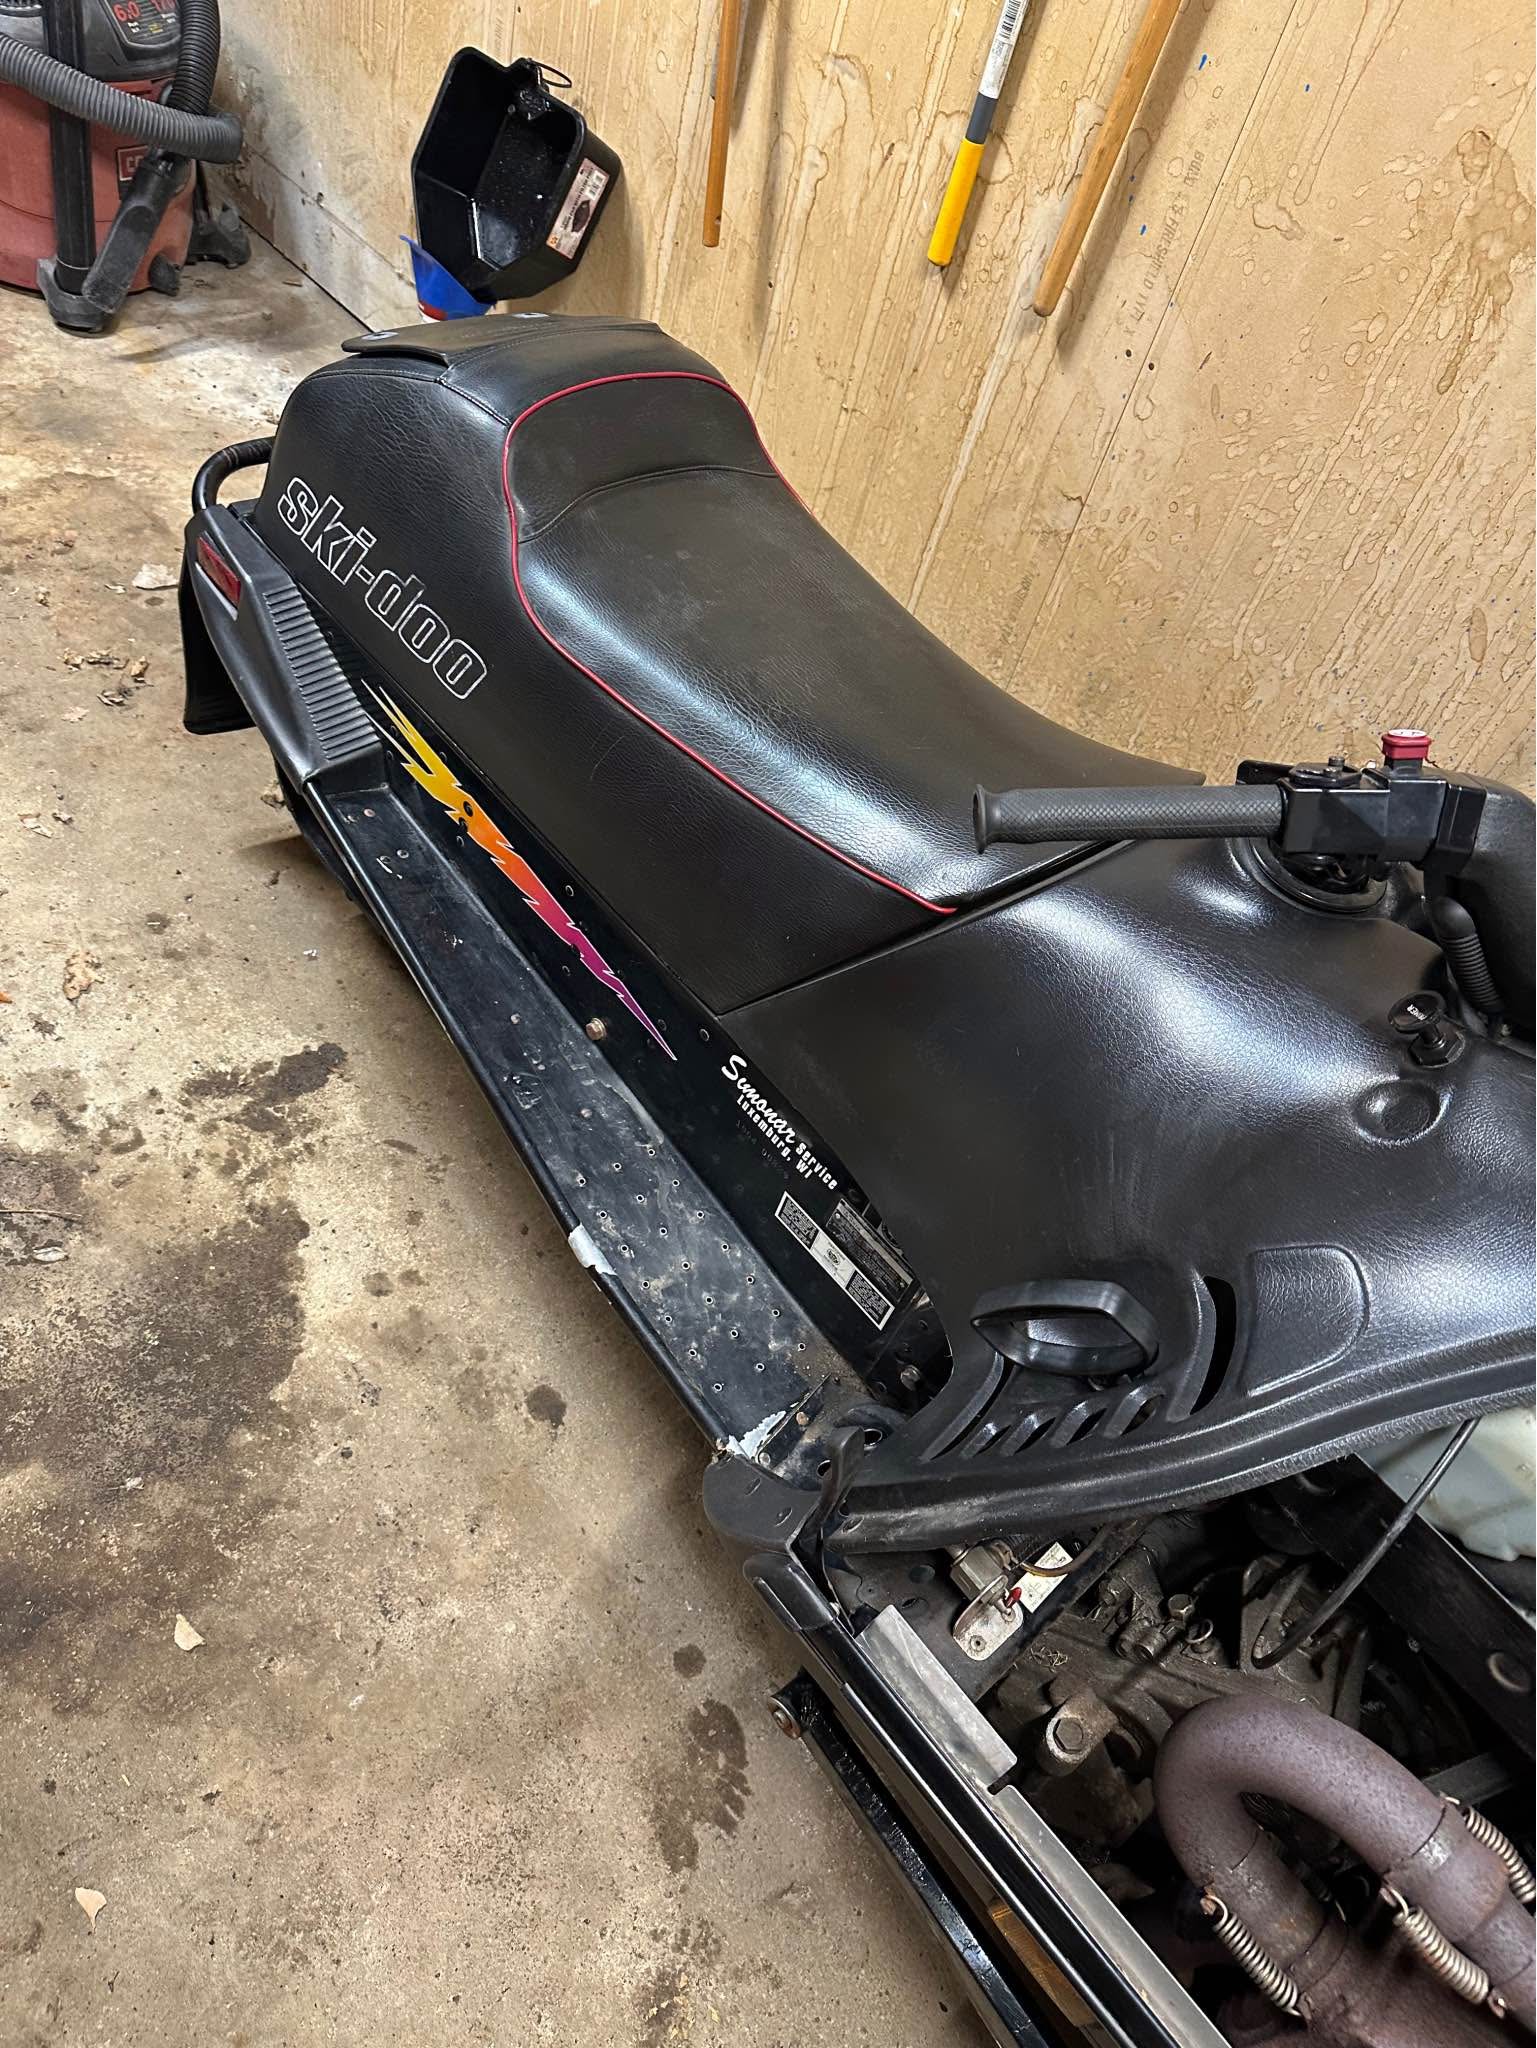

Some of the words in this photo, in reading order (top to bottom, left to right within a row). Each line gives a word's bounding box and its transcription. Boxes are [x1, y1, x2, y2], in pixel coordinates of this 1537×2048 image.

[113, 1, 141, 21] 6.0
[277, 476, 488, 700] ski-doo
[795, 1142, 838, 1190] Service
[795, 1158, 813, 1179] WI
